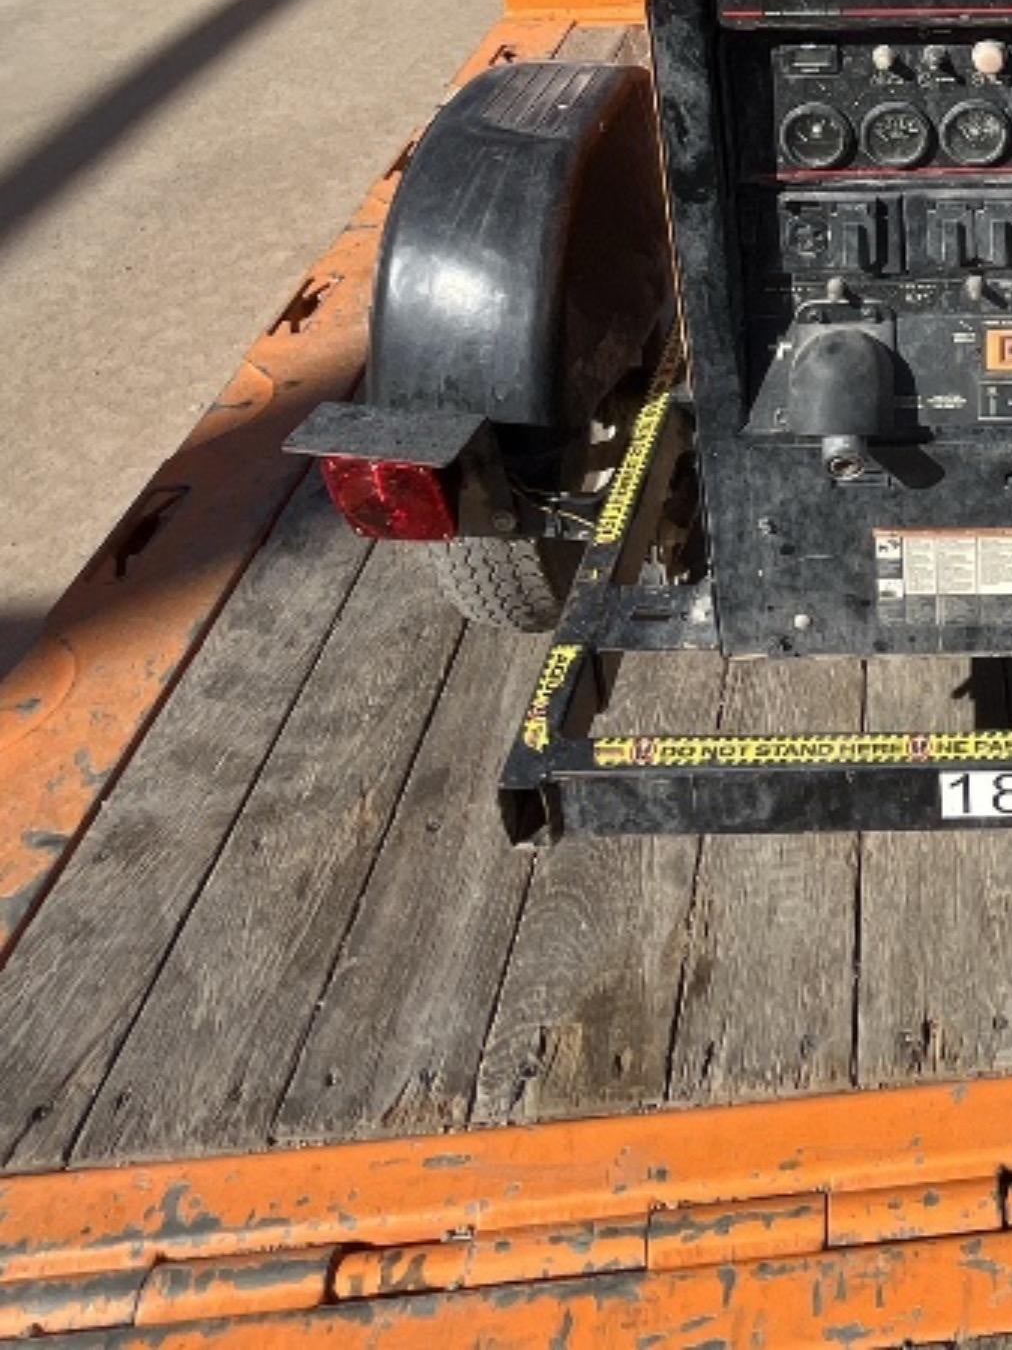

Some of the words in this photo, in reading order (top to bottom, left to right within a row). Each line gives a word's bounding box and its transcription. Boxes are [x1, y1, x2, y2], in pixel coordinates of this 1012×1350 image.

[661, 743, 695, 757] DO
[701, 743, 749, 757] NOT
[755, 742, 833, 757] STAND
[935, 740, 968, 755] NE
